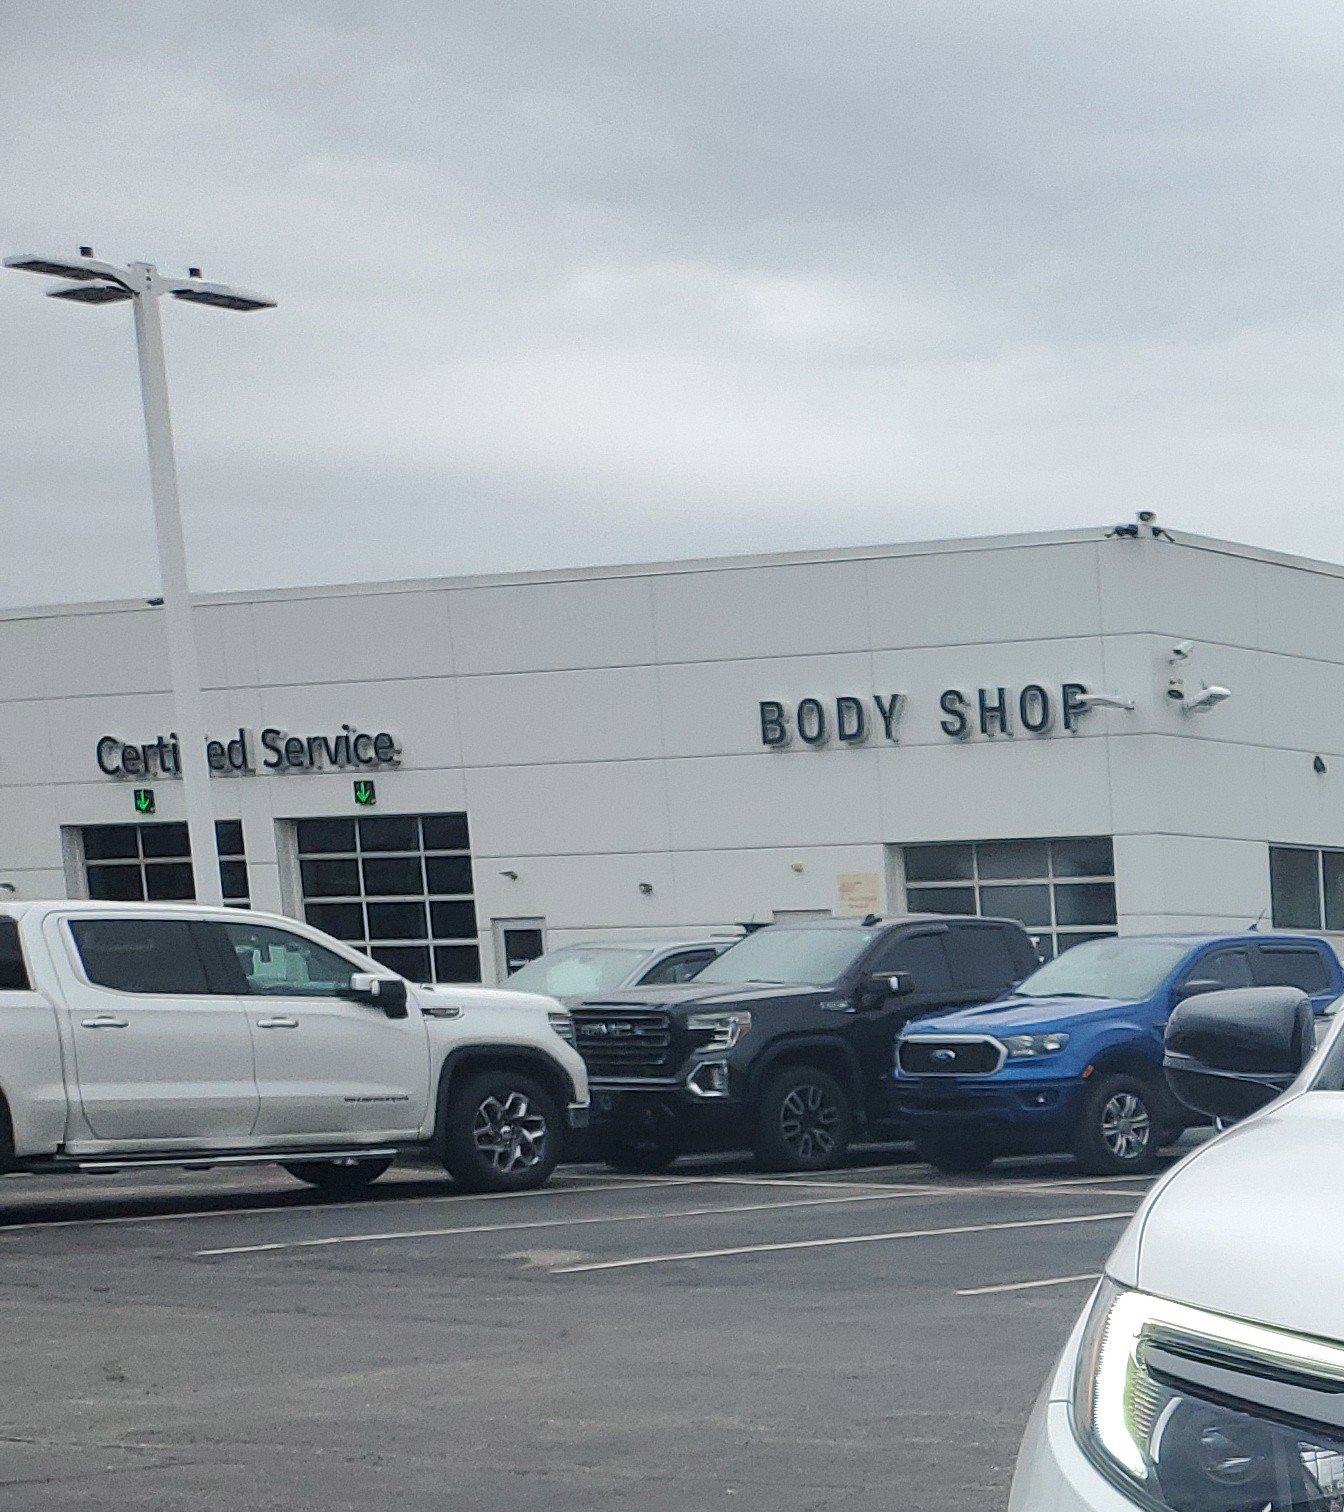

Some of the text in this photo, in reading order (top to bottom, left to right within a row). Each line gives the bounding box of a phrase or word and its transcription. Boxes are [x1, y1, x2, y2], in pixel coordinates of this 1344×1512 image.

[759, 683, 1090, 746] BODY SHOP
[96, 724, 397, 775] Certied Service
